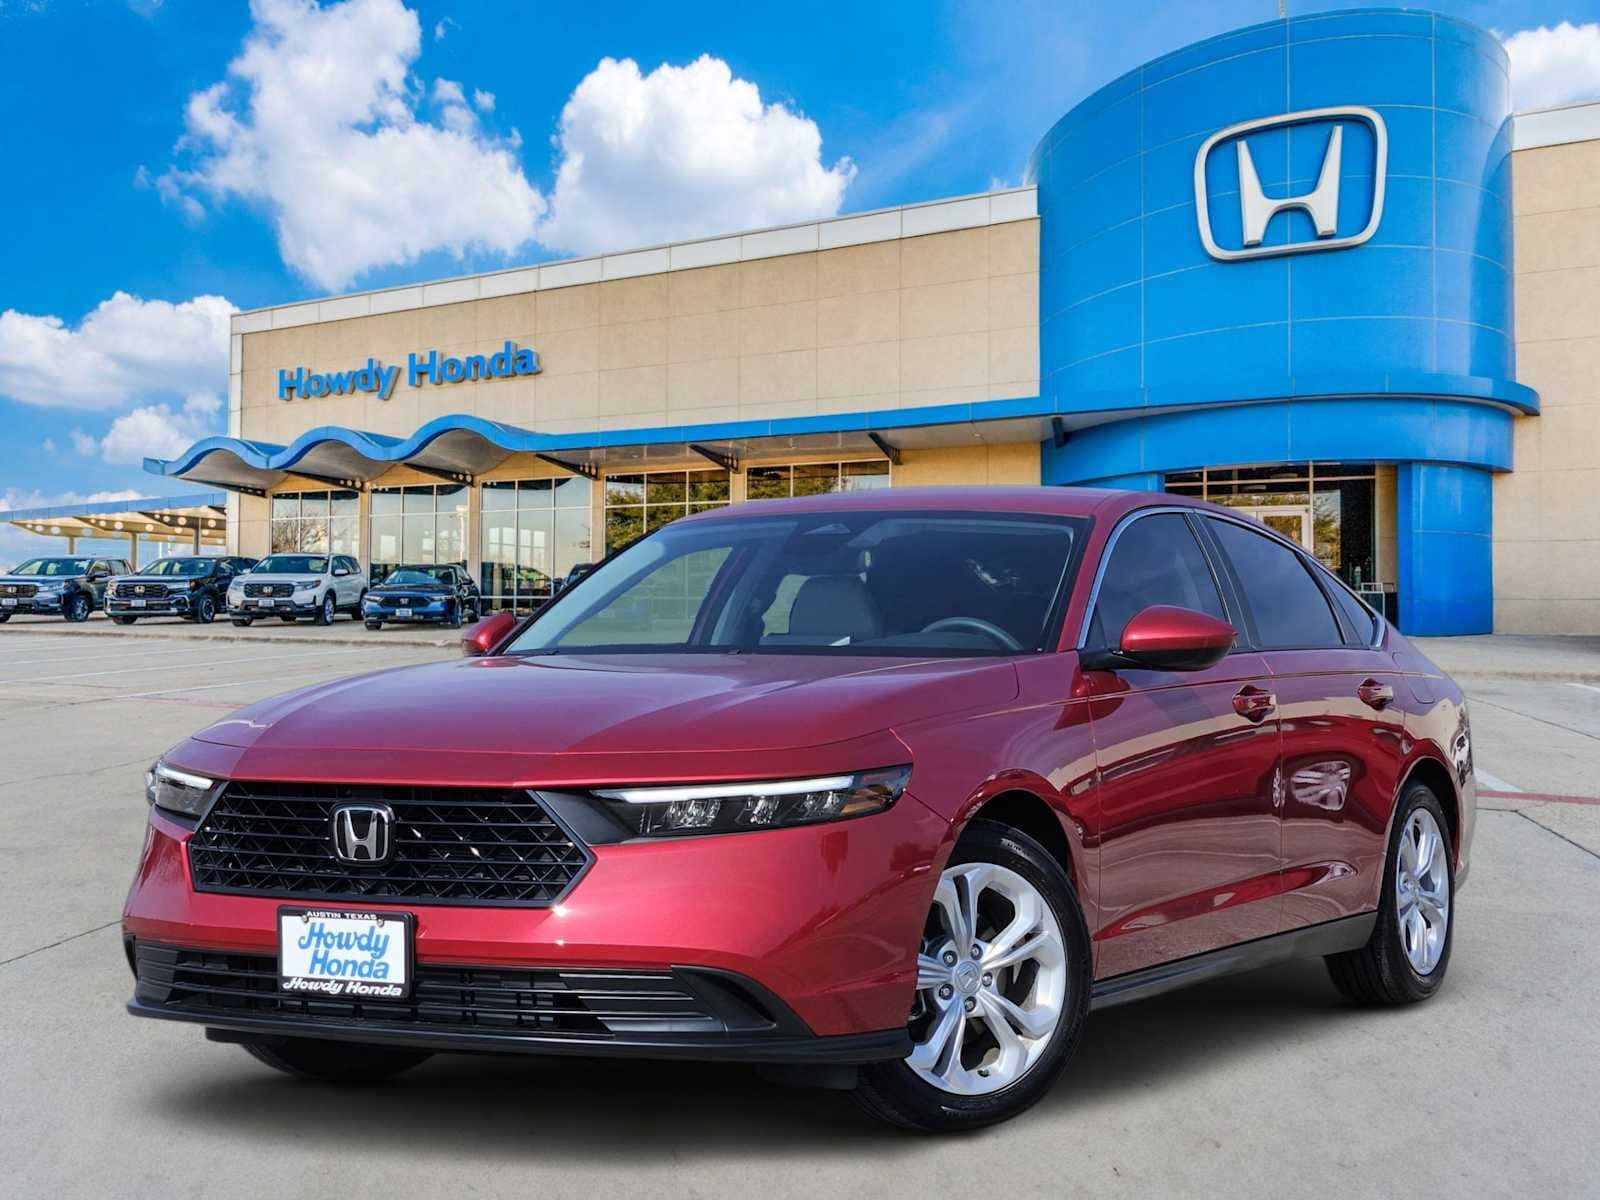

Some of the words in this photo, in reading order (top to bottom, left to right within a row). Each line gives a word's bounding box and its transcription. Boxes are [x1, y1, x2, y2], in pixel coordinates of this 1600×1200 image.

[278, 357, 400, 401] Howdy
[408, 340, 542, 388] Honda
[306, 911, 341, 919] AUSTIN
[344, 912, 377, 920] TEXAS
[298, 922, 390, 959] Howdy
[309, 949, 390, 979] Honda
[283, 977, 343, 994] Howdy
[345, 981, 403, 996] Honda
